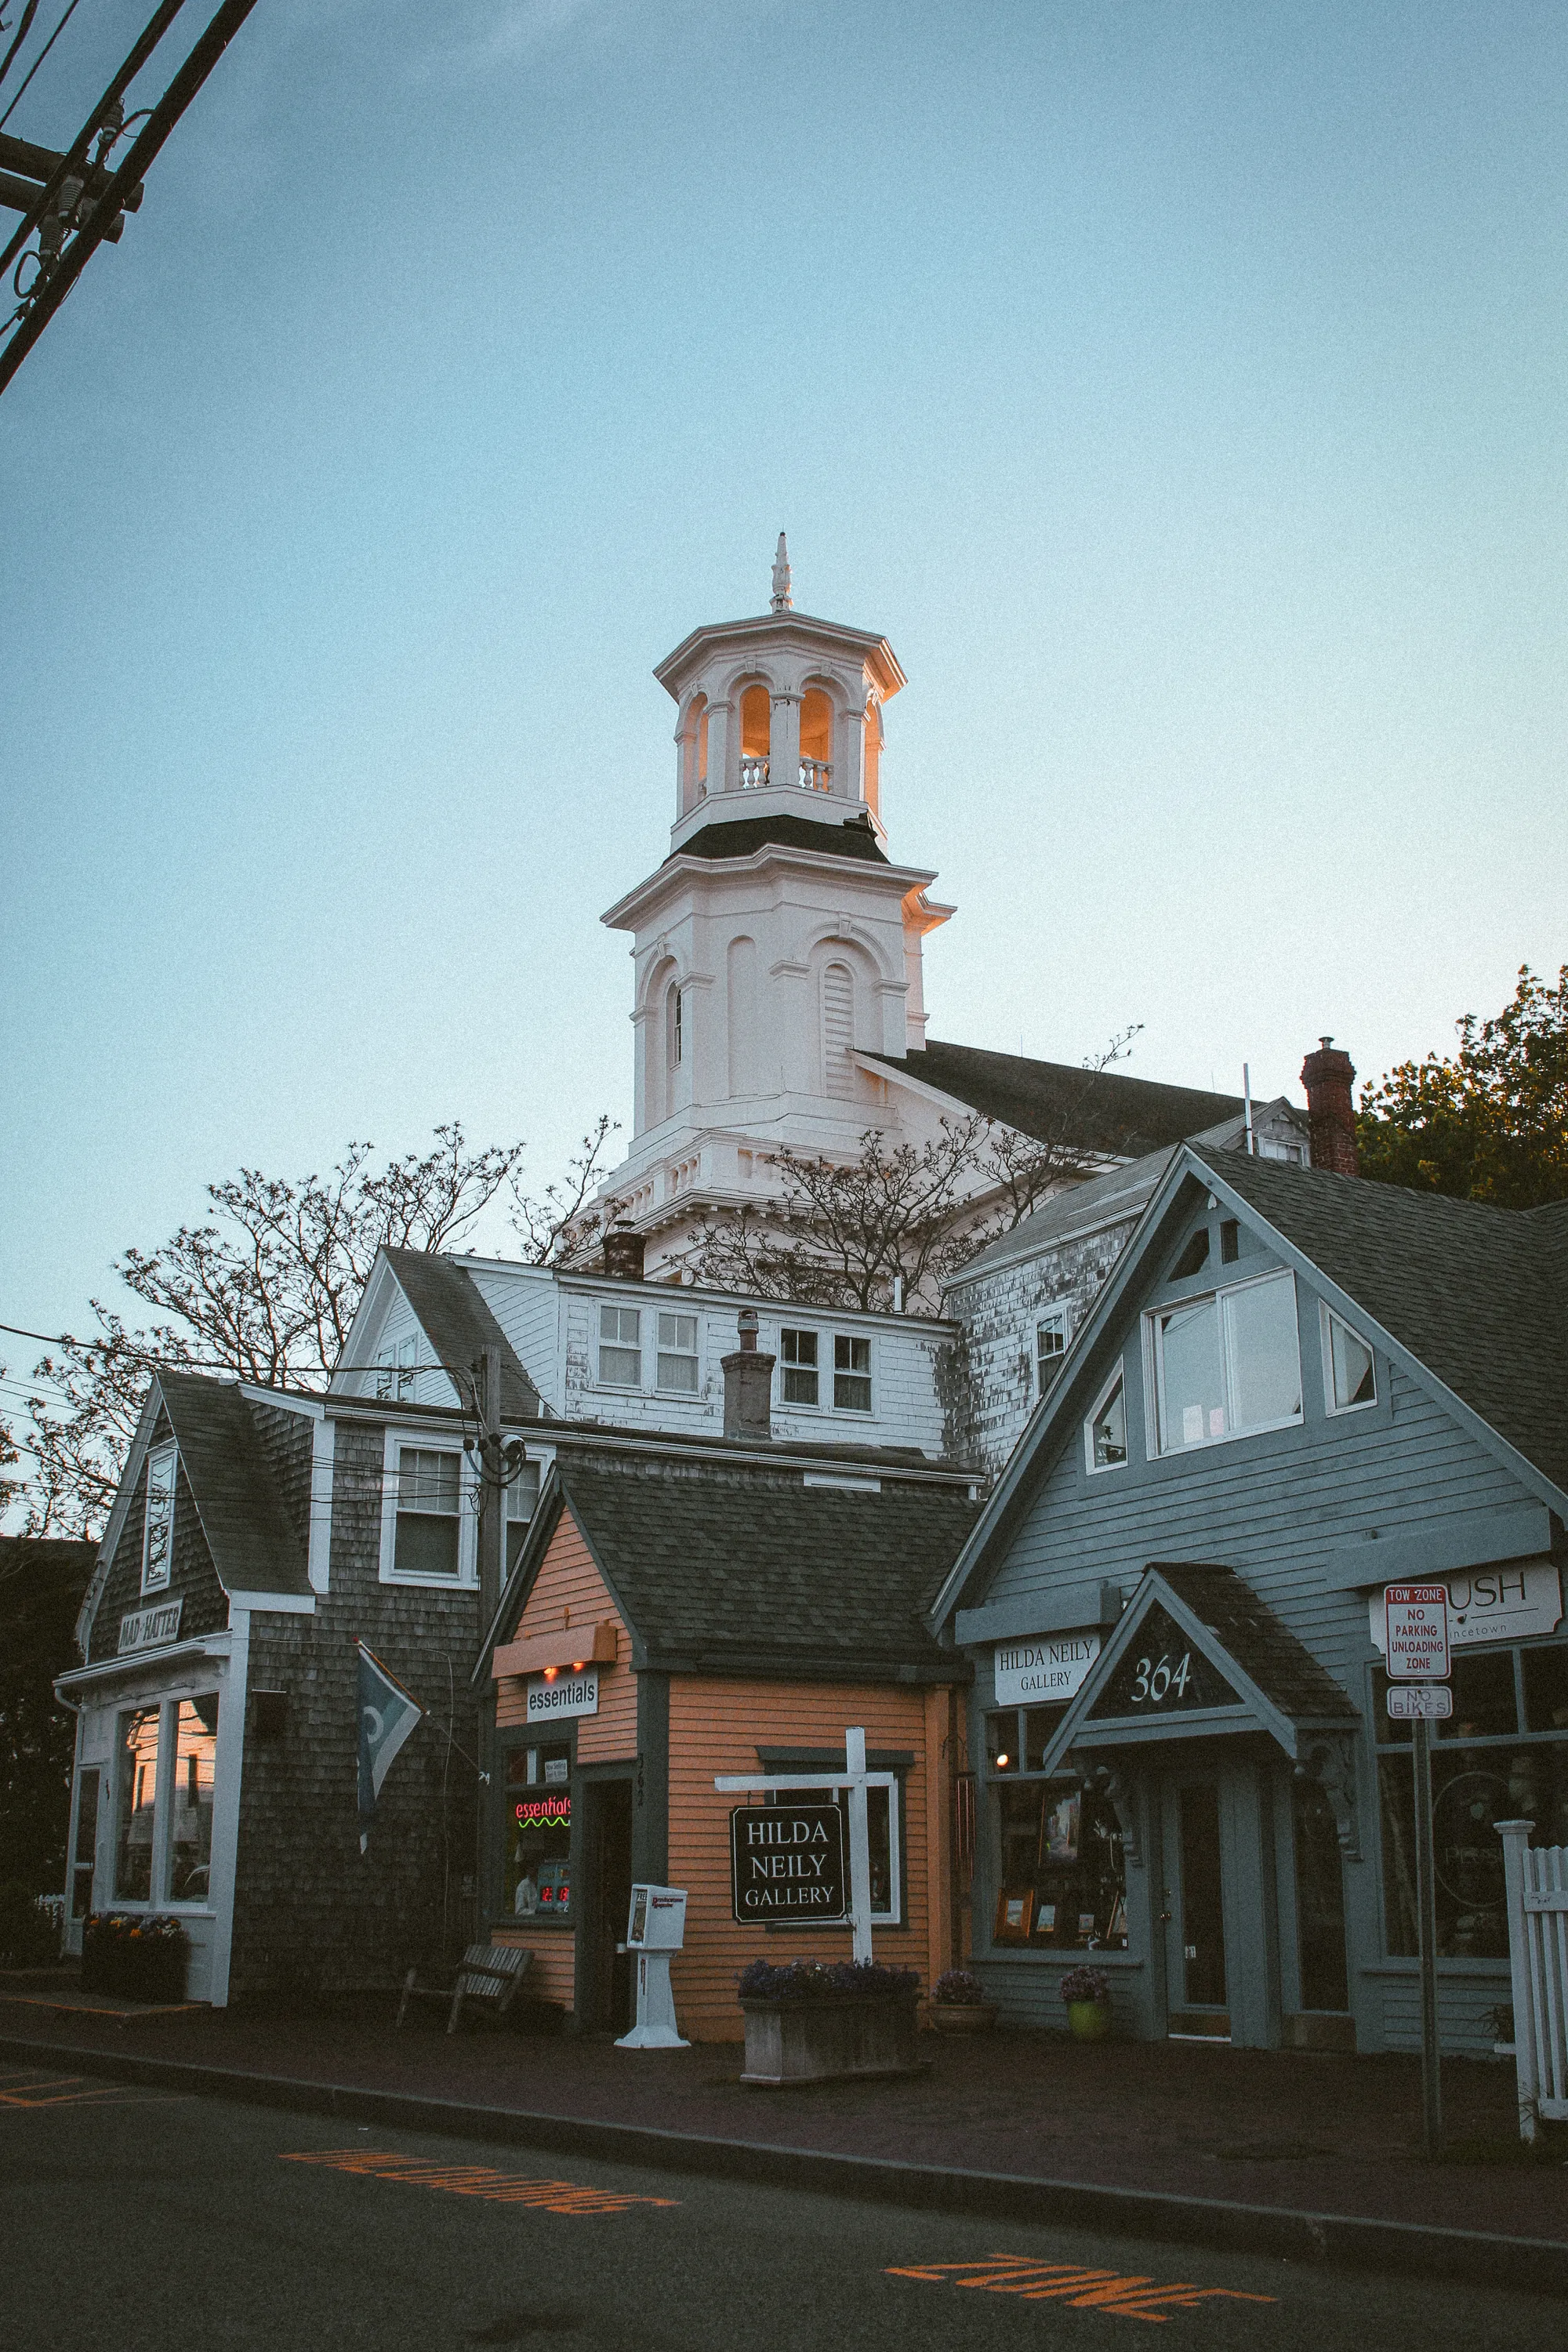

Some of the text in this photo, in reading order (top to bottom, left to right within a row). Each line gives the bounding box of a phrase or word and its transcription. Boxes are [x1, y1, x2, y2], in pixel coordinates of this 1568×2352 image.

[1389, 1588, 1443, 1601] TOW ZONE
[1448, 1571, 1526, 1610] USH
[1407, 1609, 1425, 1621] NO
[119, 1606, 180, 1648] MAD HATTER
[1396, 1625, 1438, 1636] PARKING
[1450, 1624, 1507, 1639] incetown
[1000, 1640, 1094, 1671] HILDA NEILY
[1392, 1641, 1443, 1653] UNLOADING
[1406, 1658, 1431, 1669] ZONE
[1021, 1671, 1072, 1690] GALLERY
[1131, 1653, 1191, 1701] 364
[529, 1680, 595, 1710] essentials
[1406, 1690, 1432, 1702] NO
[1394, 1702, 1446, 1714] BIKES
[747, 1820, 830, 1845] HILDA
[750, 1854, 827, 1878] NEILY
[745, 1886, 834, 1907] GALLERY
[884, 2253, 1279, 2321] ZONE
